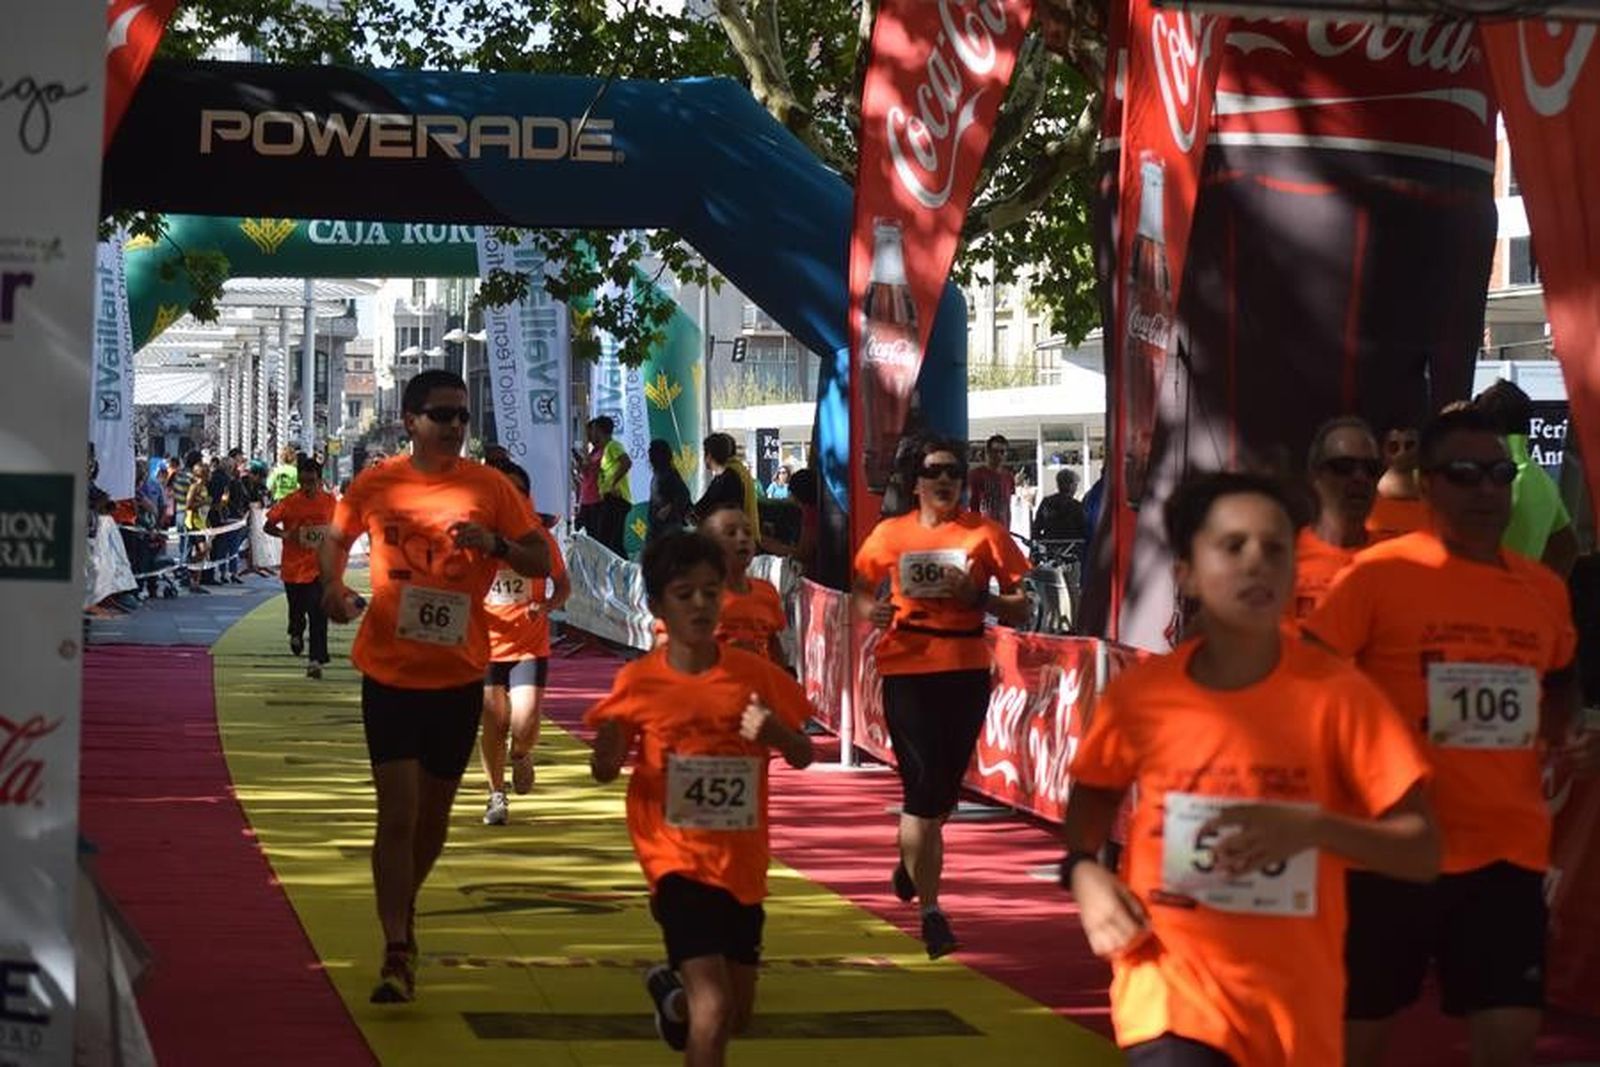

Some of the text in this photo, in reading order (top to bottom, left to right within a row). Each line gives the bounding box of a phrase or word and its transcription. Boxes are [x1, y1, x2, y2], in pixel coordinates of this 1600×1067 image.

[201, 110, 605, 162] POWERADE
[308, 219, 390, 245] CAJA
[419, 603, 450, 628] 66
[1451, 687, 1521, 722] 106
[684, 778, 746, 808] 452
